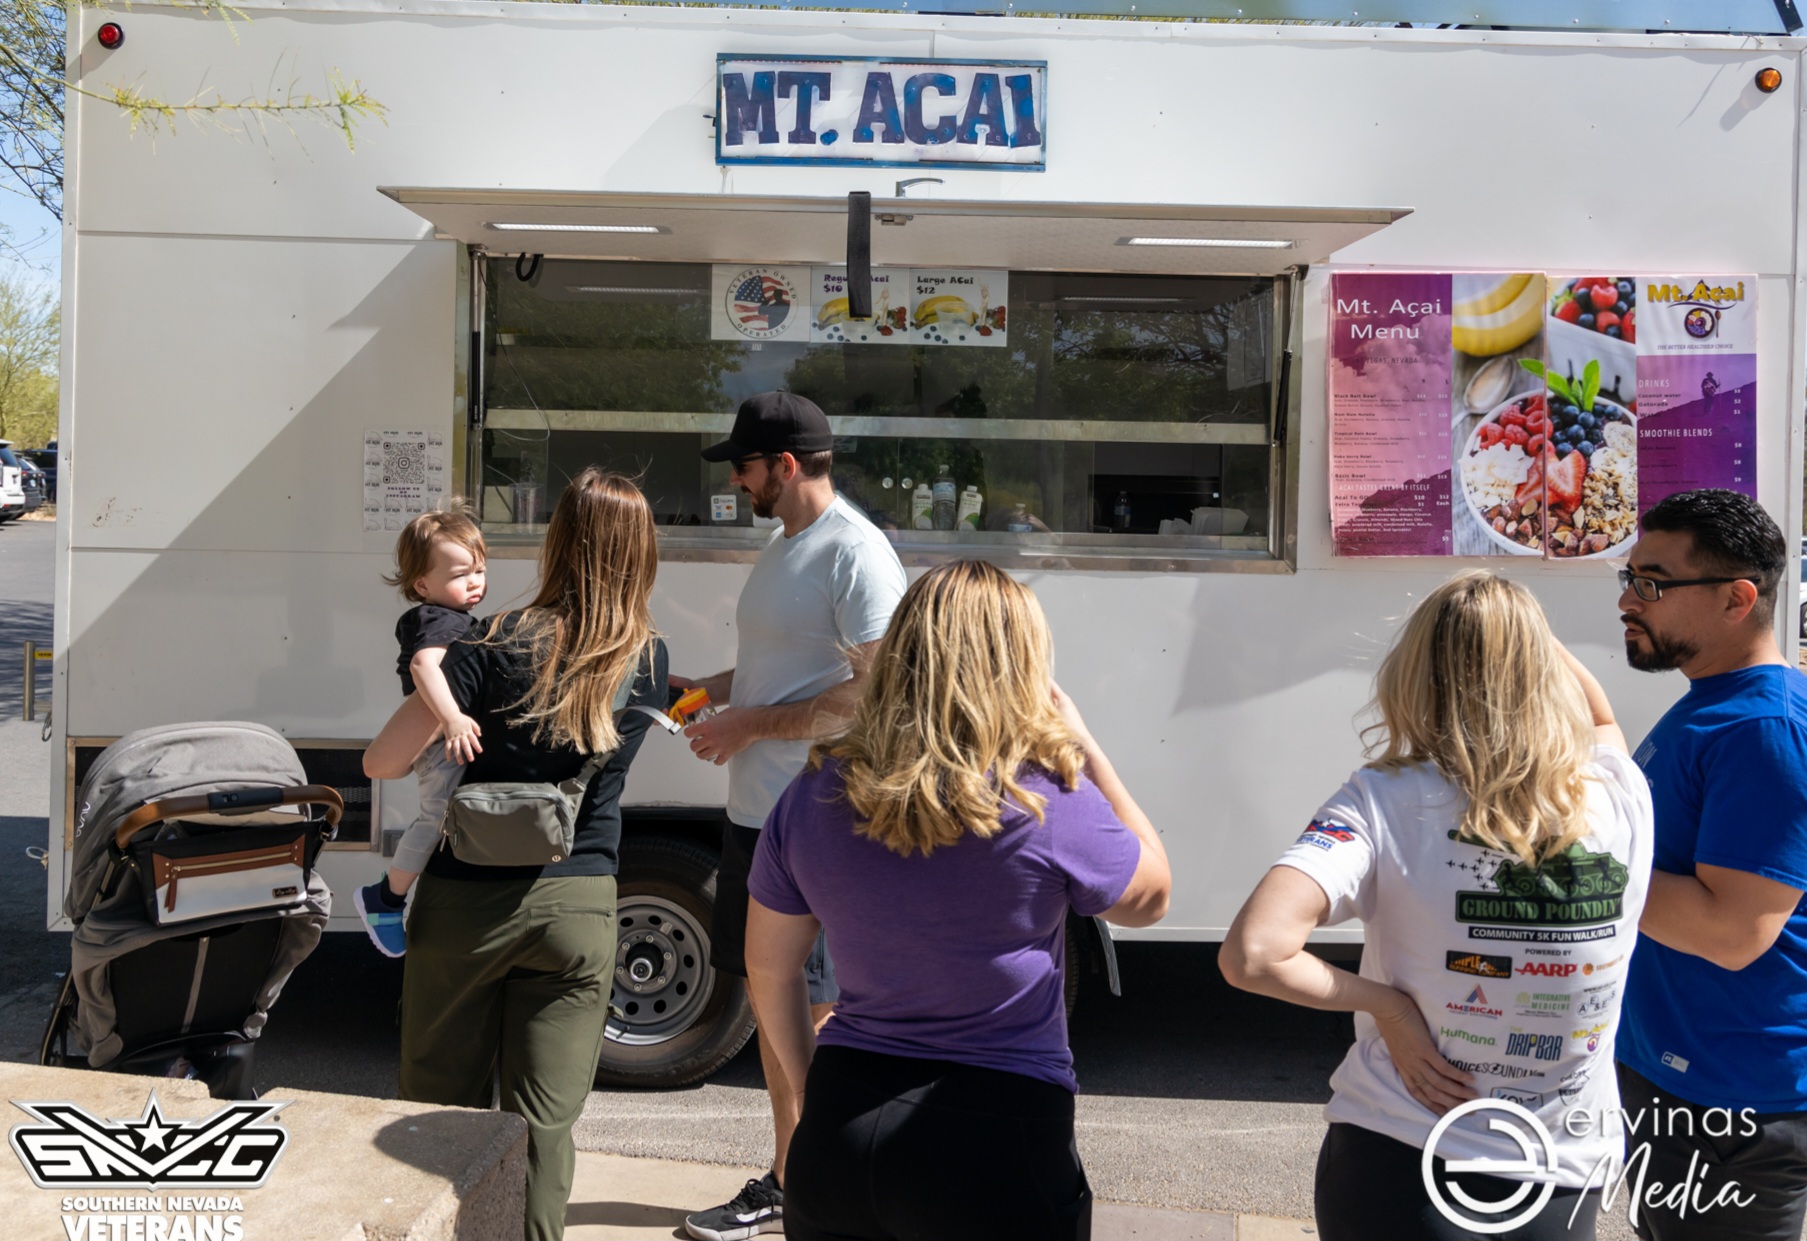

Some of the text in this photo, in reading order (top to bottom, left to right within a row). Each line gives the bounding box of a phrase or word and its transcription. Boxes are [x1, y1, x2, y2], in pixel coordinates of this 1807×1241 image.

[722, 70, 1042, 149] MT. ACAI
[728, 268, 797, 299] VETERAN OWNED
[824, 274, 848, 283] Regu
[917, 276, 946, 286] Large
[823, 284, 843, 293] $10
[916, 286, 935, 295] $12
[1647, 281, 1745, 305] Mt. Açai
[1336, 298, 1441, 318] Mt. Açai
[737, 324, 786, 337] OPERATED
[1351, 324, 1419, 339] Menu
[1638, 379, 1670, 388] DRINKS
[1639, 428, 1713, 438] SMOOTHIE BLENDS
[1462, 899, 1540, 920] GROUND
[1472, 927, 1614, 942] COMMUNITY 5K FUN WALK/RUN
[1525, 948, 1561, 956] POWERED
[1516, 962, 1578, 977] AARP
[1532, 993, 1572, 1002] INTEGRATIVE
[1445, 1001, 1503, 1017] AMERICAN
[1531, 1002, 1570, 1011] MEDICINE
